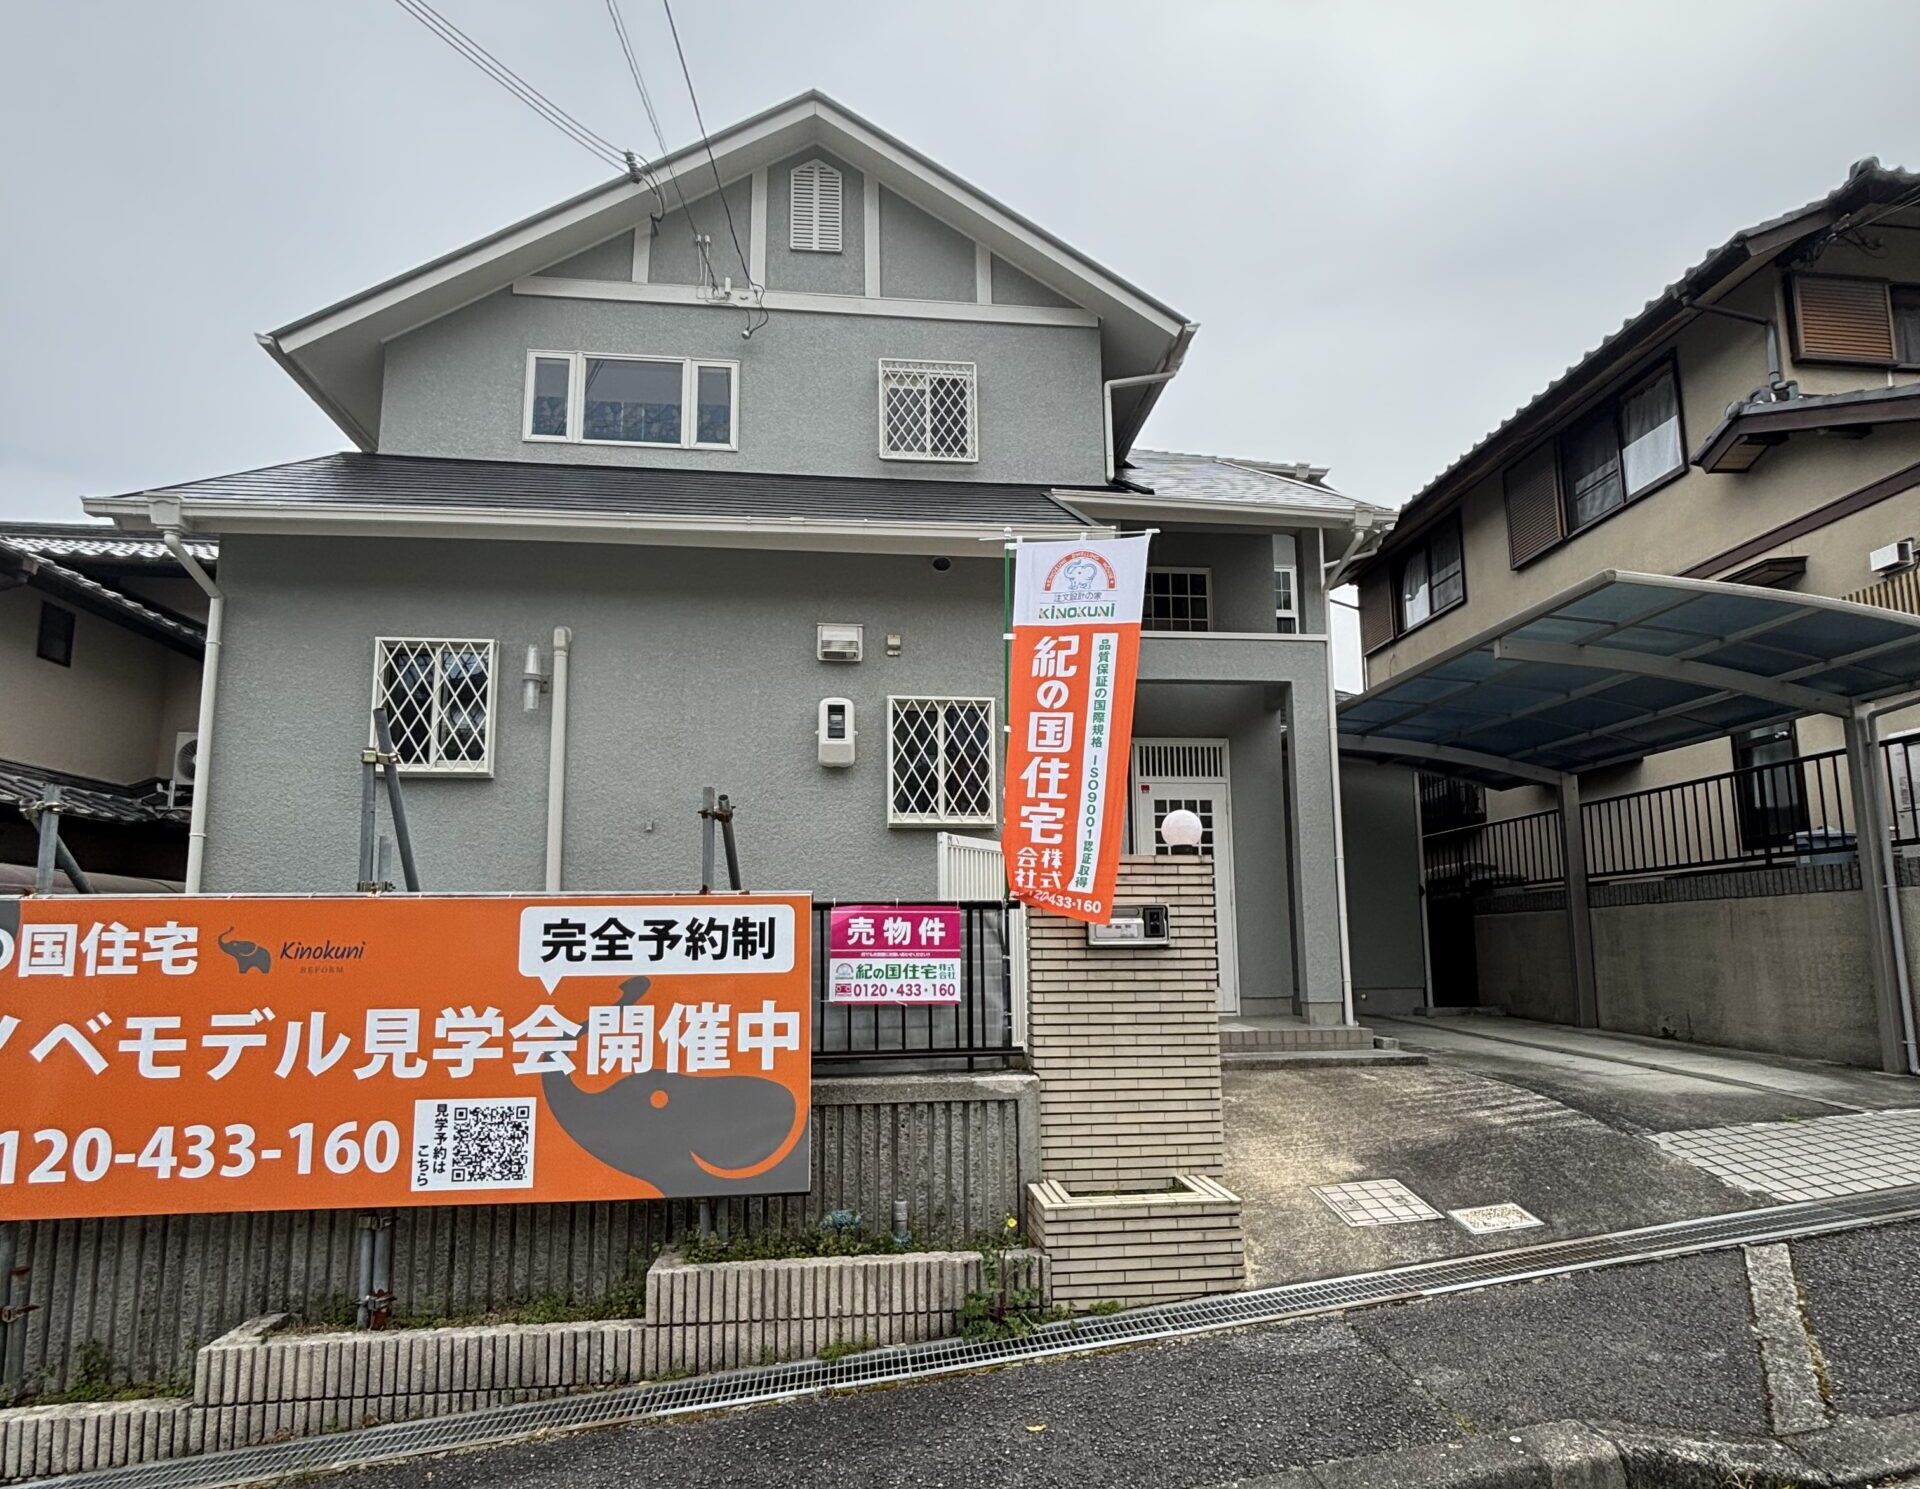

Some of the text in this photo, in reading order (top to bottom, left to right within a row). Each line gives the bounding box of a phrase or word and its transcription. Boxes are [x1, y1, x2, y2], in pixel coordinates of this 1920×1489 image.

[1019, 635, 1080, 844] 紀の国住宅
[0, 921, 199, 978] 国住宅
[280, 940, 366, 960] Kinokuni
[541, 916, 776, 962] 完全予約制
[847, 917, 946, 945] 売物件
[300, 966, 344, 974] REFORM
[856, 963, 937, 979] 紀の国住宅
[432, 1103, 449, 1174] 見学予約は
[416, 1145, 430, 1187] こちら
